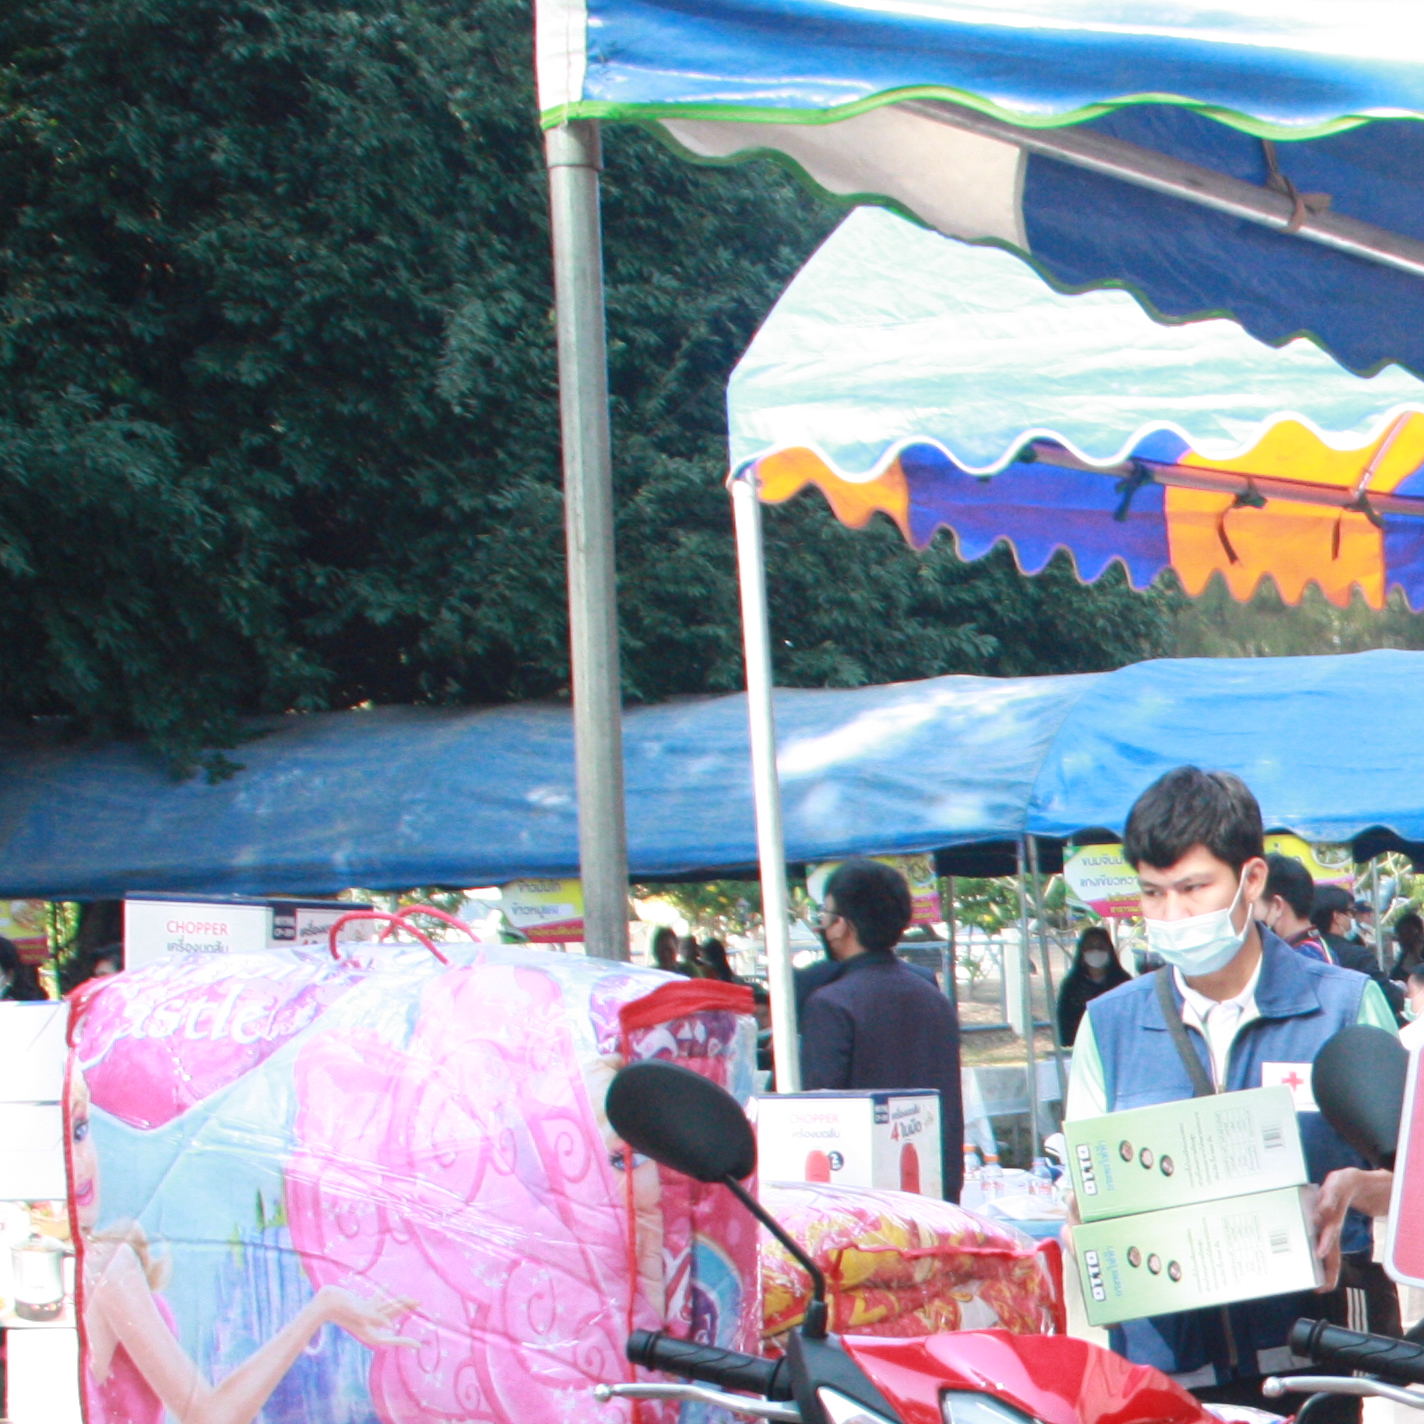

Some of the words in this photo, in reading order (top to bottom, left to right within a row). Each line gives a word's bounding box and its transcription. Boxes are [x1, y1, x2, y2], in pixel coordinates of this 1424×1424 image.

[166, 919, 230, 937] CHOPPER
[789, 1112, 840, 1125] CHOPPER
[1076, 1144, 1099, 1196] OTTO
[1084, 1250, 1106, 1302] OTTO
